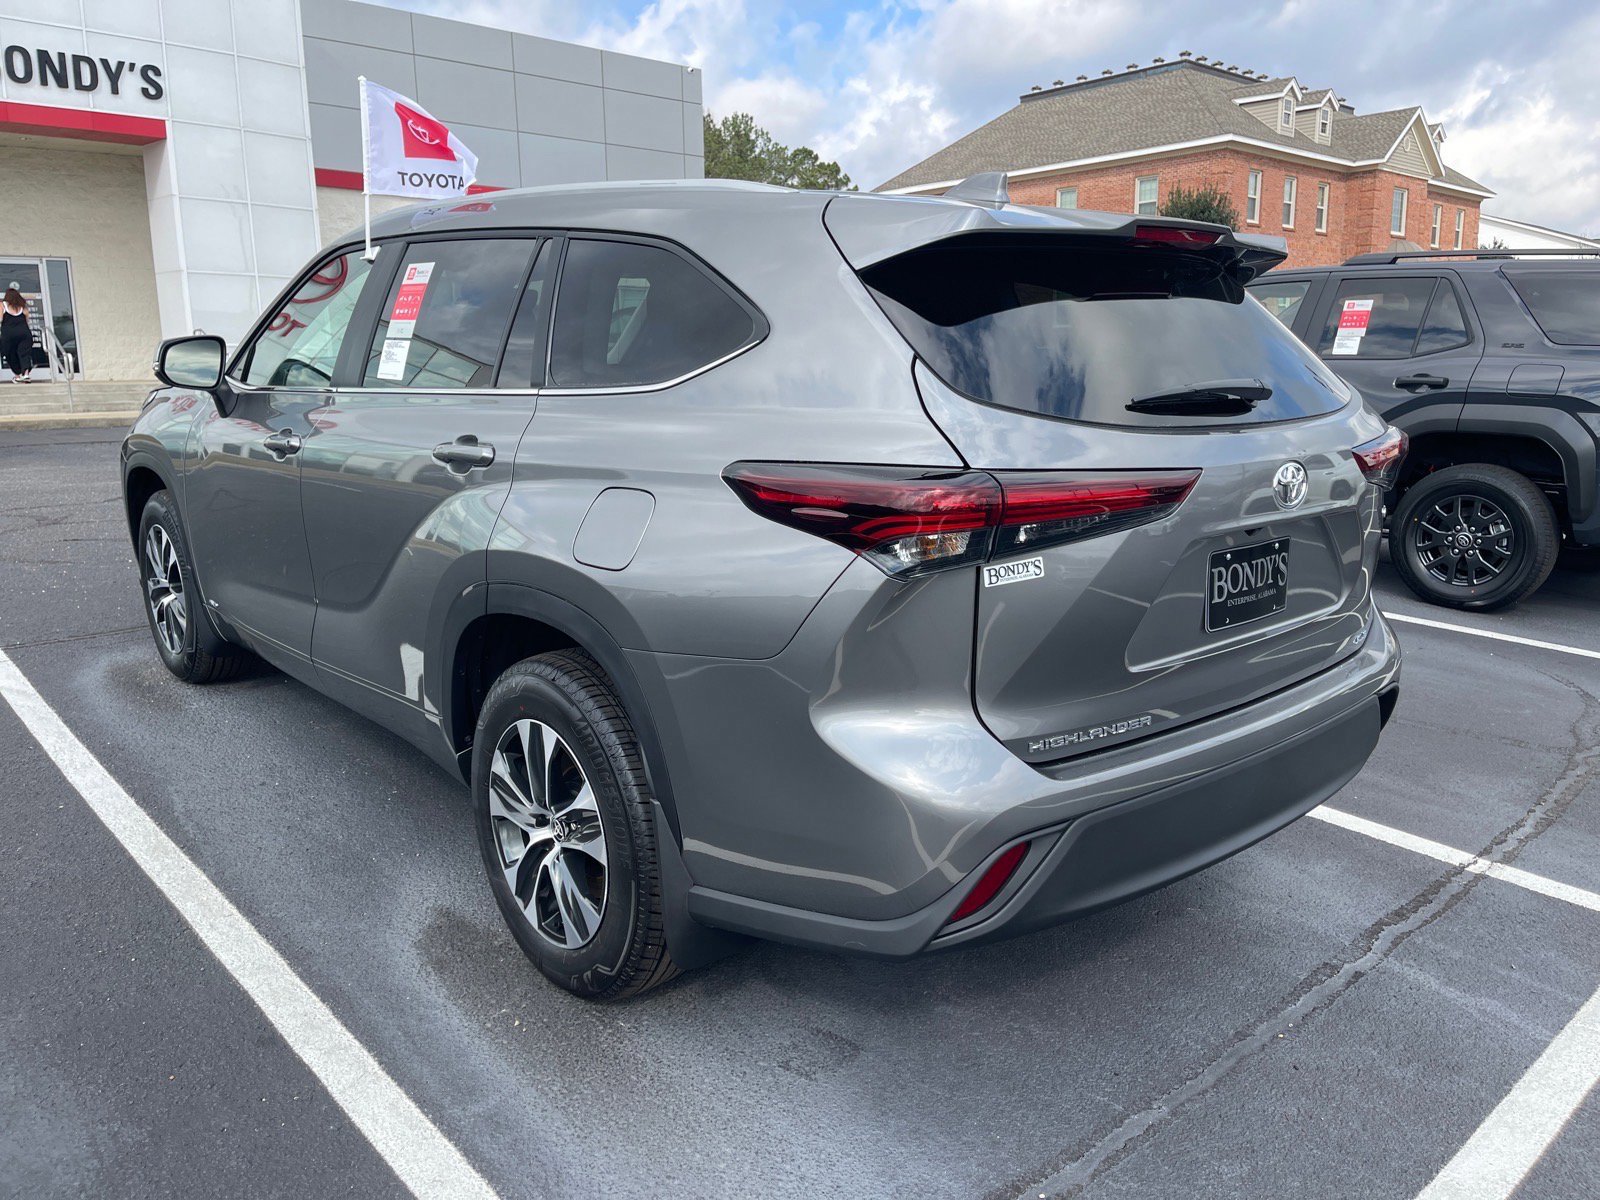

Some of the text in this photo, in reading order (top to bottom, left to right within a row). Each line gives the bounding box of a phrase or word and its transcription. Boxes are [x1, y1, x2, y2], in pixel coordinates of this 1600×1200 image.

[0, 44, 164, 100] ONDY'S
[397, 171, 465, 190] TOYOTA
[985, 559, 1043, 586] BONDY'S
[1211, 552, 1288, 604] BONDY'S
[1028, 715, 1152, 753] HIGHLANDER
